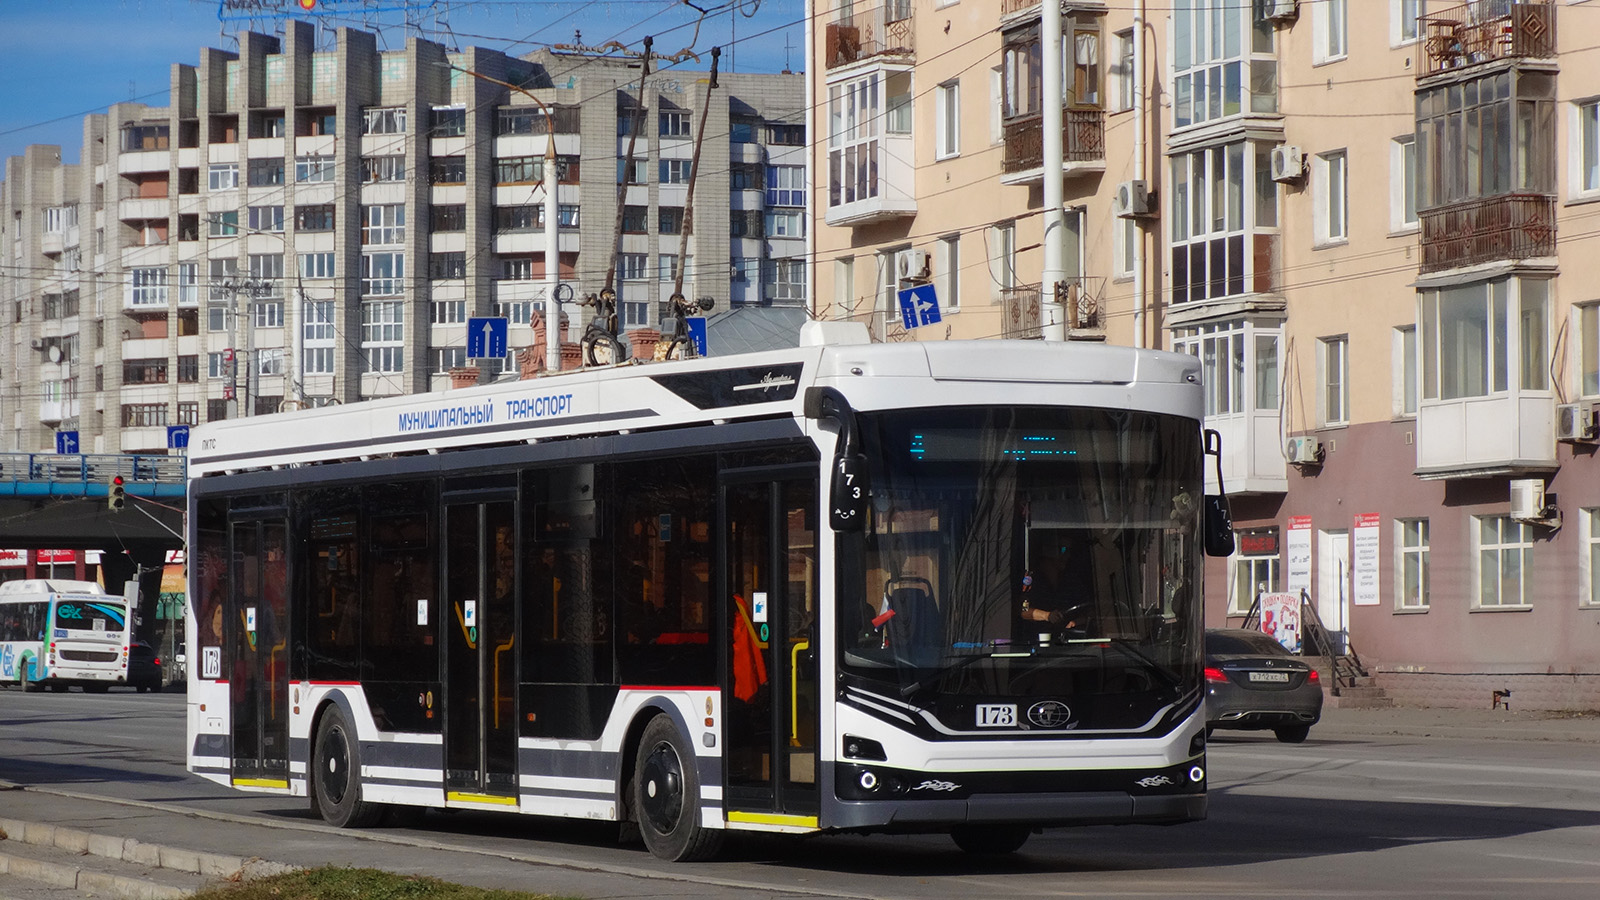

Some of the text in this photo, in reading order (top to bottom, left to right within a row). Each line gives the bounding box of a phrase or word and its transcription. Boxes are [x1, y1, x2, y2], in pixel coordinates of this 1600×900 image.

[398, 393, 573, 432] МУНИЦИПАЛЬНЫЙ ТРАНСПОРТ
[204, 650, 219, 674] 173
[980, 706, 1013, 725] 173
